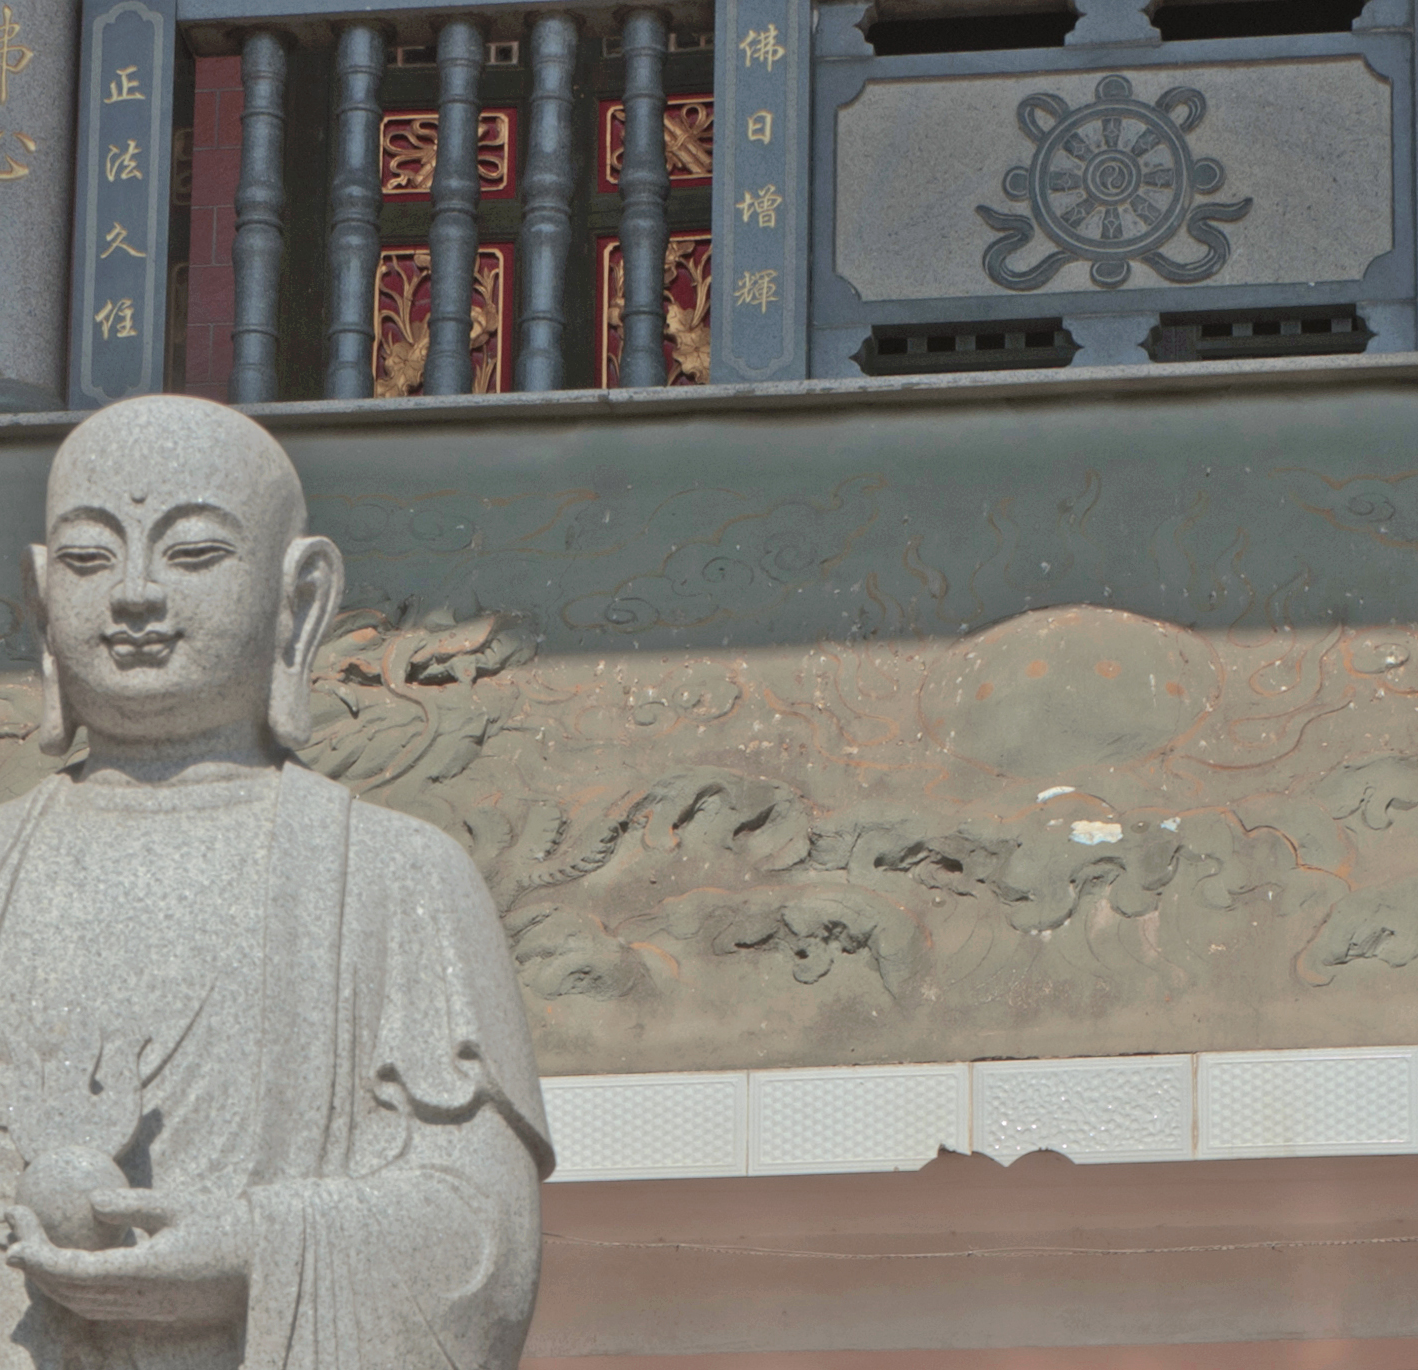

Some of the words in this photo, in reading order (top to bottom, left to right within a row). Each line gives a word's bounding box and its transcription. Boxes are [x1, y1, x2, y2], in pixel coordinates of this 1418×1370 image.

[94, 65, 148, 341] 正法久住
[734, 24, 785, 314] 佛日增輝
